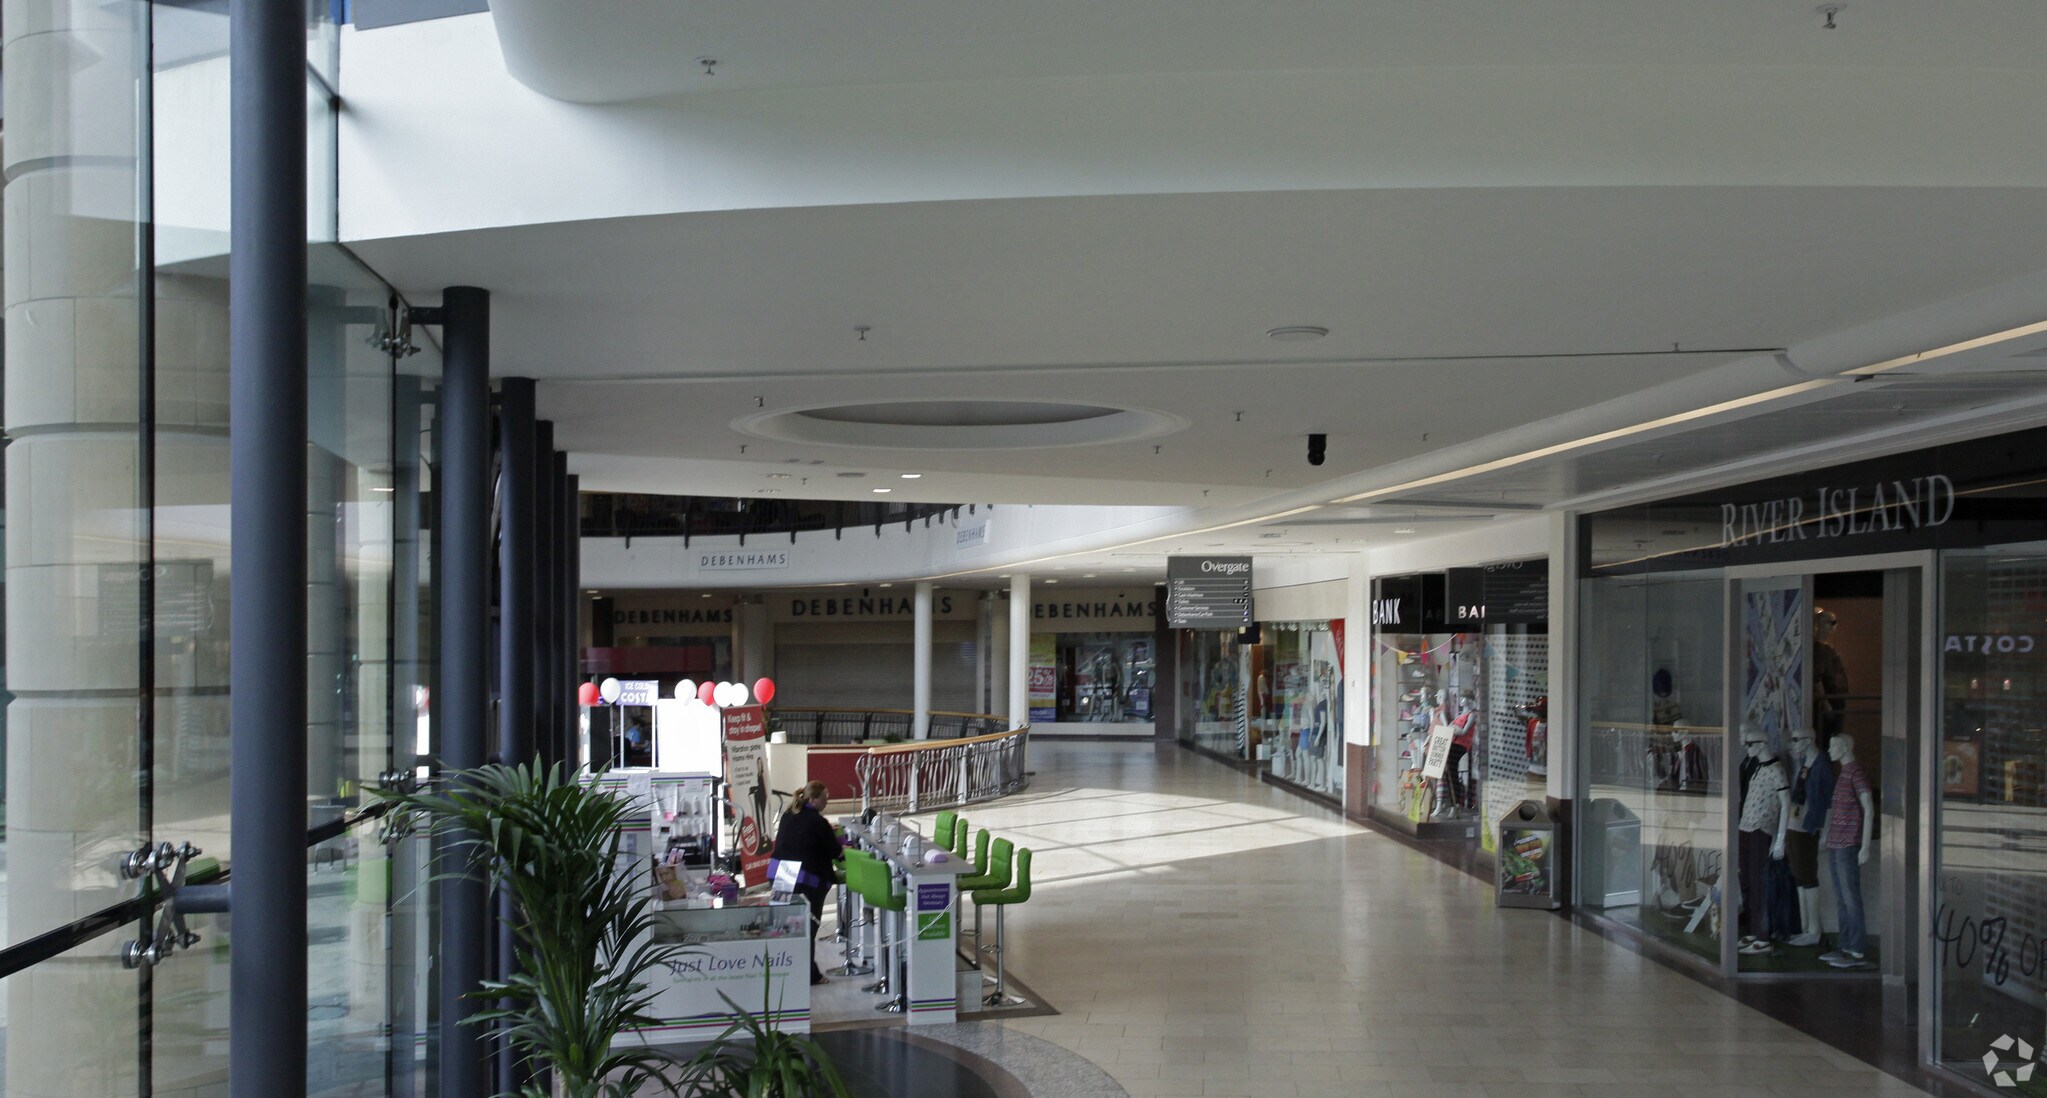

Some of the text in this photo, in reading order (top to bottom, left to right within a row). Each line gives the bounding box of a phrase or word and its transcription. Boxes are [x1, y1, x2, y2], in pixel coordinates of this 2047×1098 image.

[1721, 474, 1955, 549] RIVER ISLAND
[701, 553, 786, 567] DEBENHAMS
[1201, 560, 1250, 575] Overgate
[792, 597, 952, 616] DEBENHAS
[1030, 602, 1156, 618] EBENHAMS
[1373, 598, 1400, 624] BANK
[613, 608, 733, 625] DEBENHAMS
[1934, 903, 2010, 986] 40%
[669, 951, 793, 976] Just Love Nails
